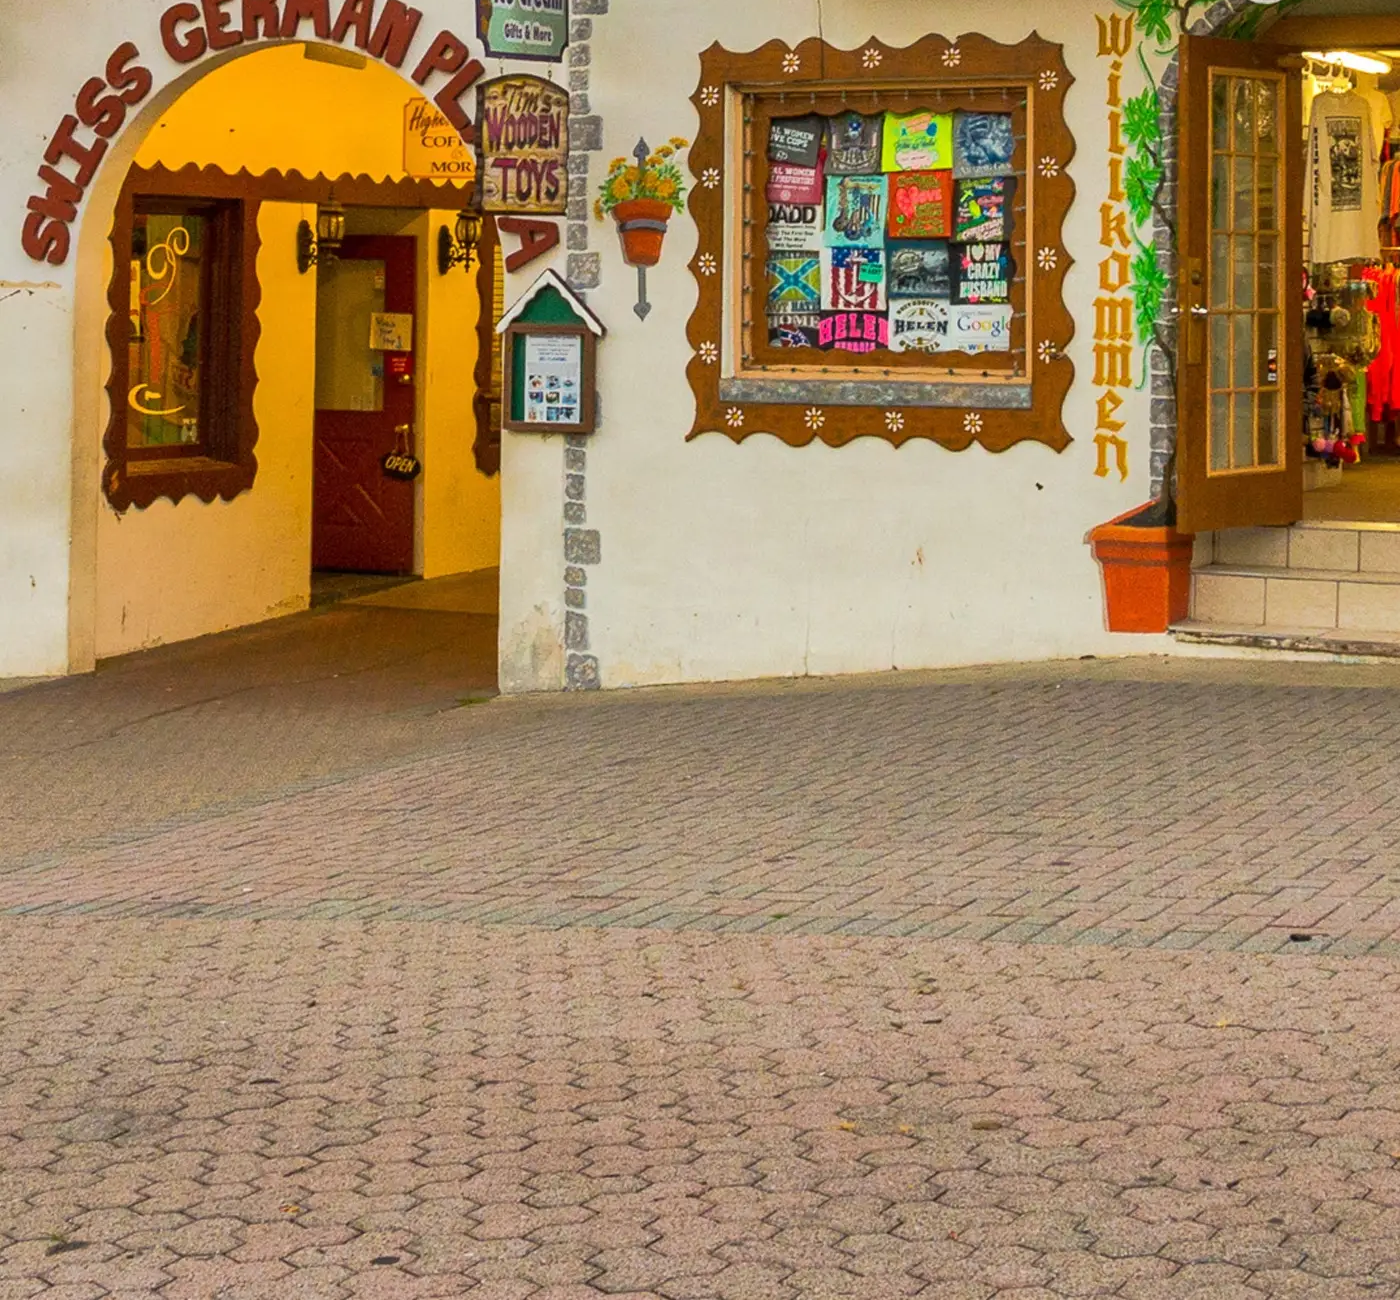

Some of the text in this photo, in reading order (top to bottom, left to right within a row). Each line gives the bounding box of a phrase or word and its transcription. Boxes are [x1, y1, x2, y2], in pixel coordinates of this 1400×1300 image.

[504, 23, 552, 42] Gifts & More
[409, 101, 449, 137] Highe
[484, 104, 561, 150] WOODEN
[421, 136, 463, 148] COF
[783, 127, 815, 141] WOMEN
[786, 136, 809, 148] COPS
[22, 41, 153, 266] SWISS
[411, 30, 560, 274] PLA
[431, 161, 472, 173] MOR
[491, 157, 560, 202] TOYS
[966, 244, 1002, 261] I MY
[967, 262, 1000, 279] CRAZY
[959, 280, 1008, 298] HUSBAND
[894, 319, 949, 336] HELEN
[384, 455, 416, 474] OPEN
